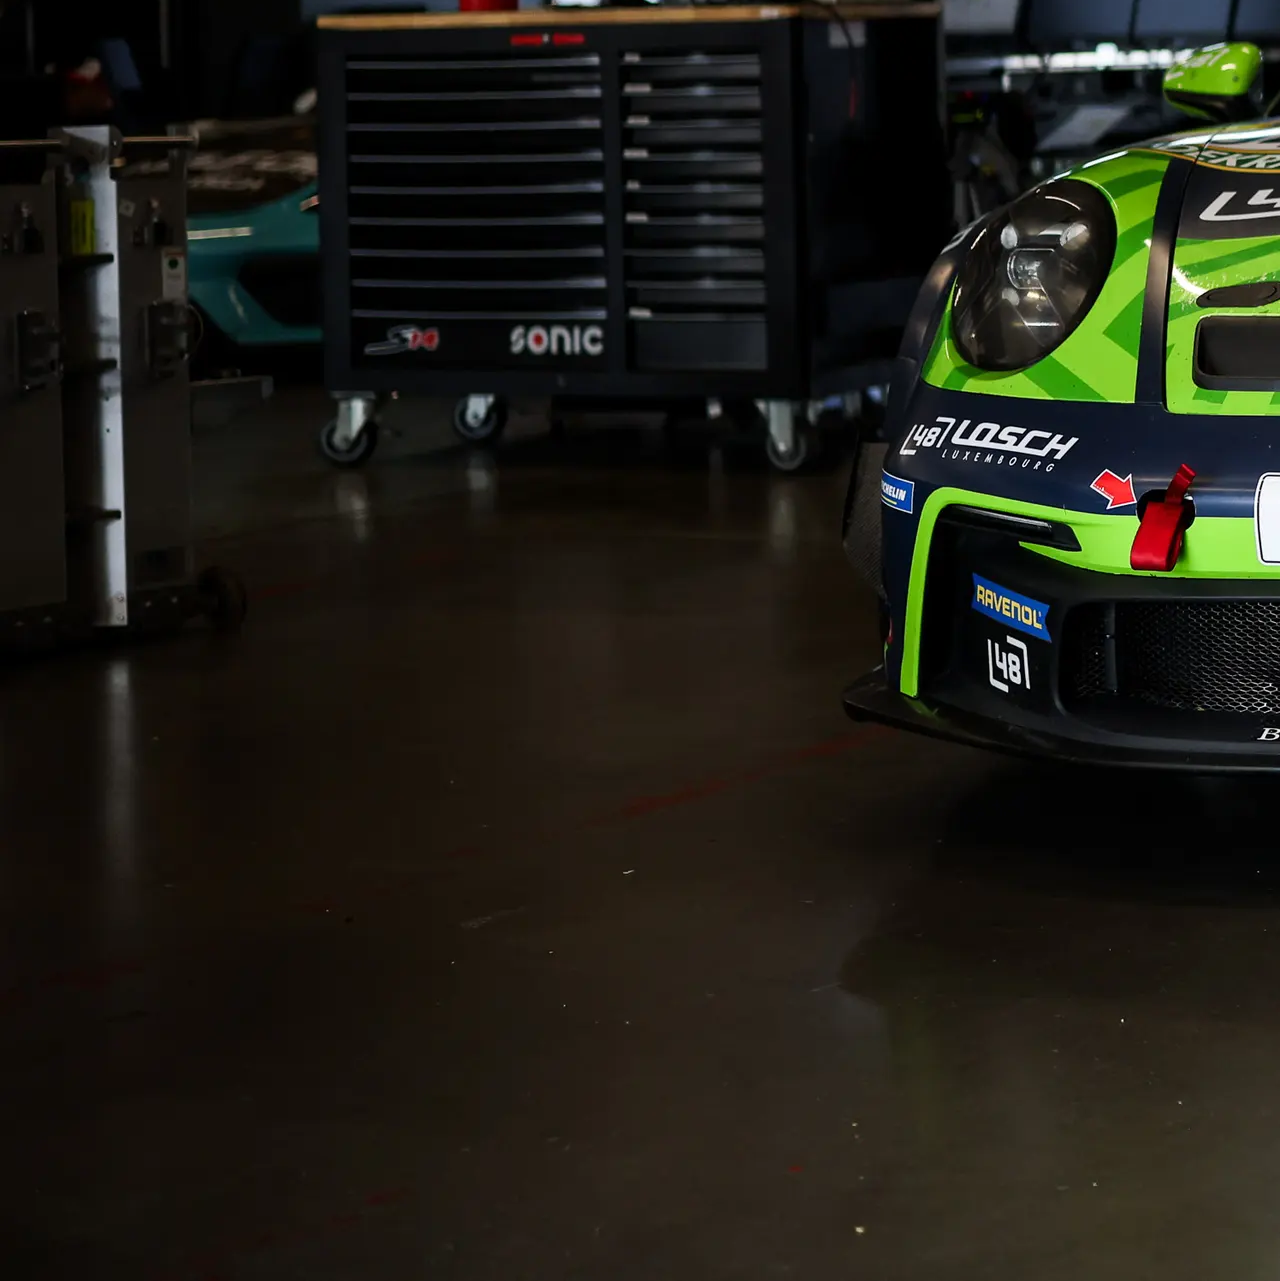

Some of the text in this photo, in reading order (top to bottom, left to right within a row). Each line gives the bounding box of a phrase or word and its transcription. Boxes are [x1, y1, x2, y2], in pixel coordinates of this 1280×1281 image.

[509, 324, 604, 356] SONIC
[951, 420, 1079, 460] LOSCH
[942, 449, 1055, 472] LUXEMBOURG
[977, 584, 1042, 630] RAVENOL
